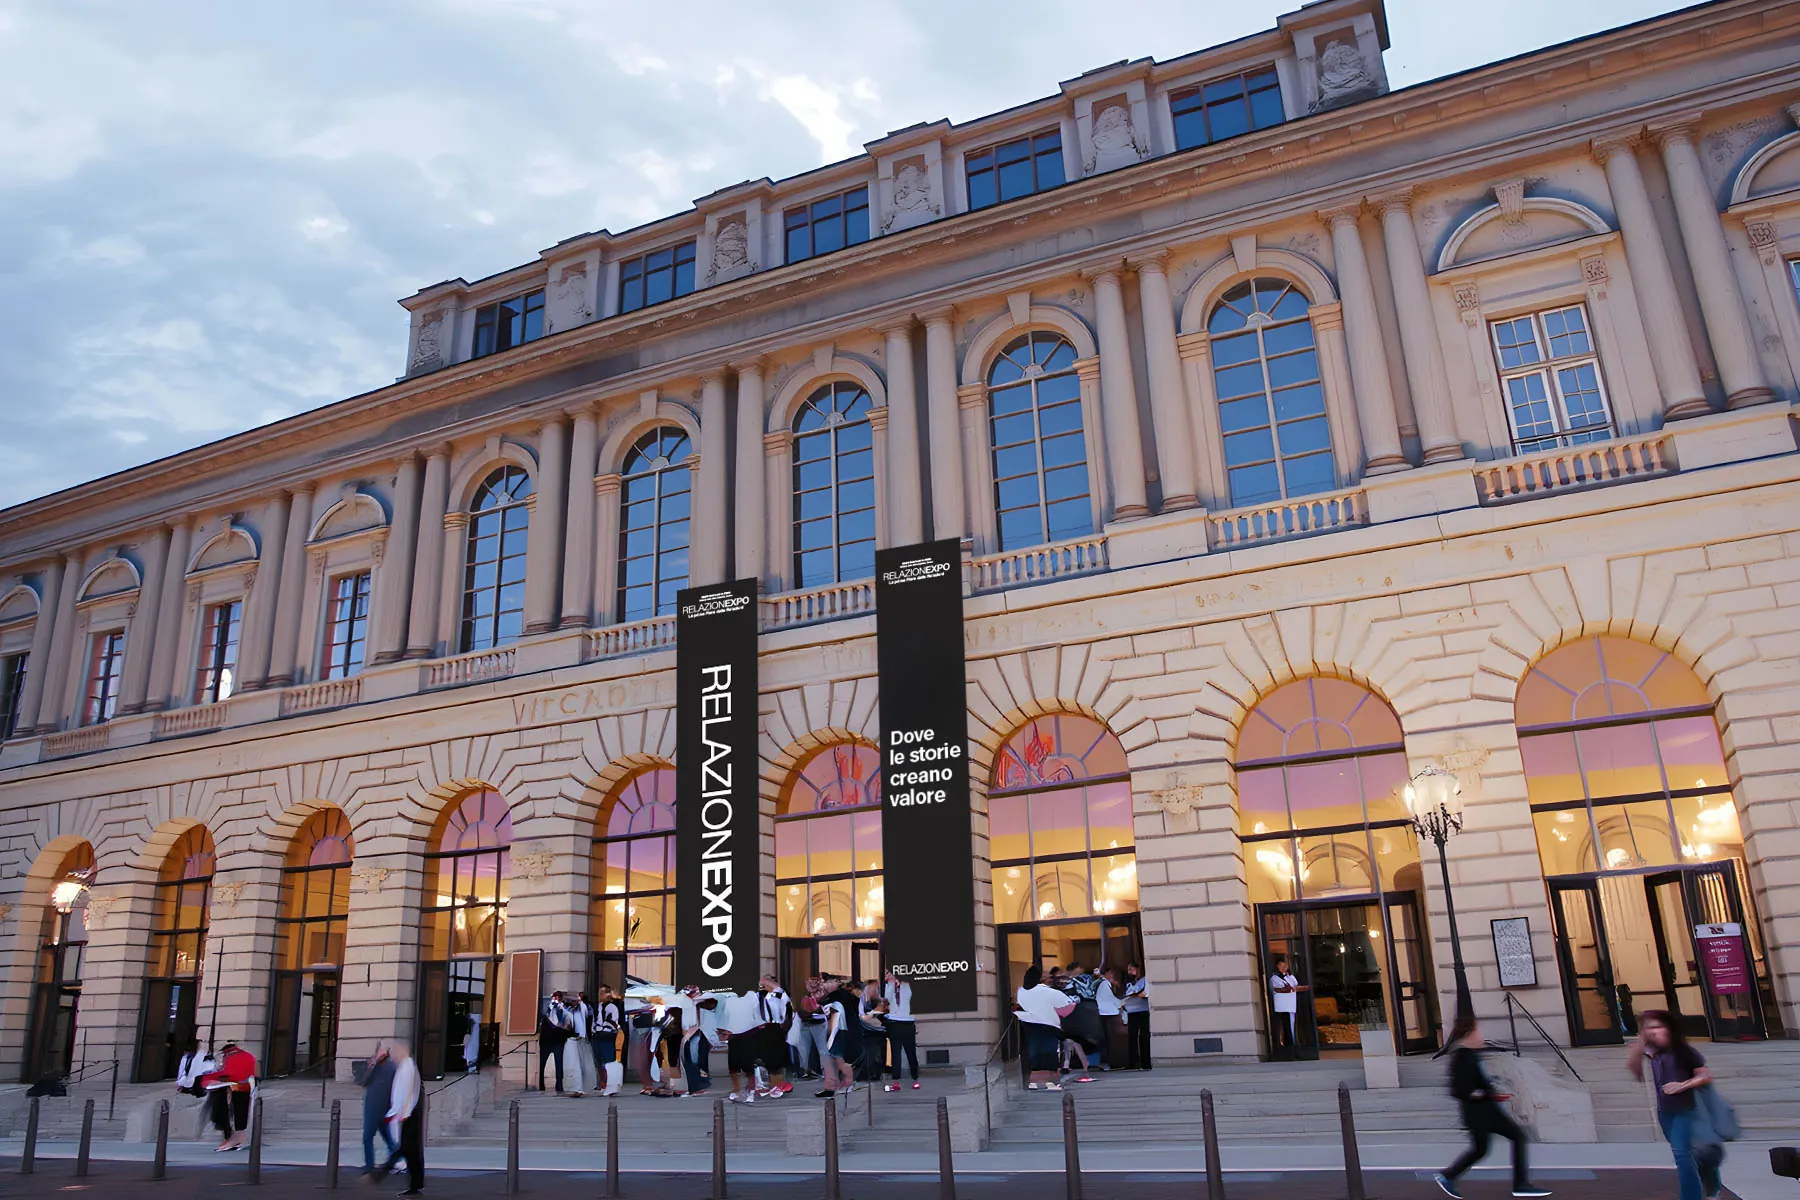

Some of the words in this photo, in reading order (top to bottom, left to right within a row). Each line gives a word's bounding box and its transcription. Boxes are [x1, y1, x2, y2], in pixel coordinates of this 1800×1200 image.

[883, 563, 951, 581] RELAZIONEXPO
[682, 596, 750, 615] RELAZIONEXPO
[890, 728, 935, 746] Dove
[889, 749, 905, 766] le
[909, 742, 962, 763] storie
[890, 767, 953, 786] creano
[889, 788, 947, 808] valore
[701, 663, 734, 977] RELAZIONEXPO
[892, 961, 969, 976] RELAZIONEXPO
